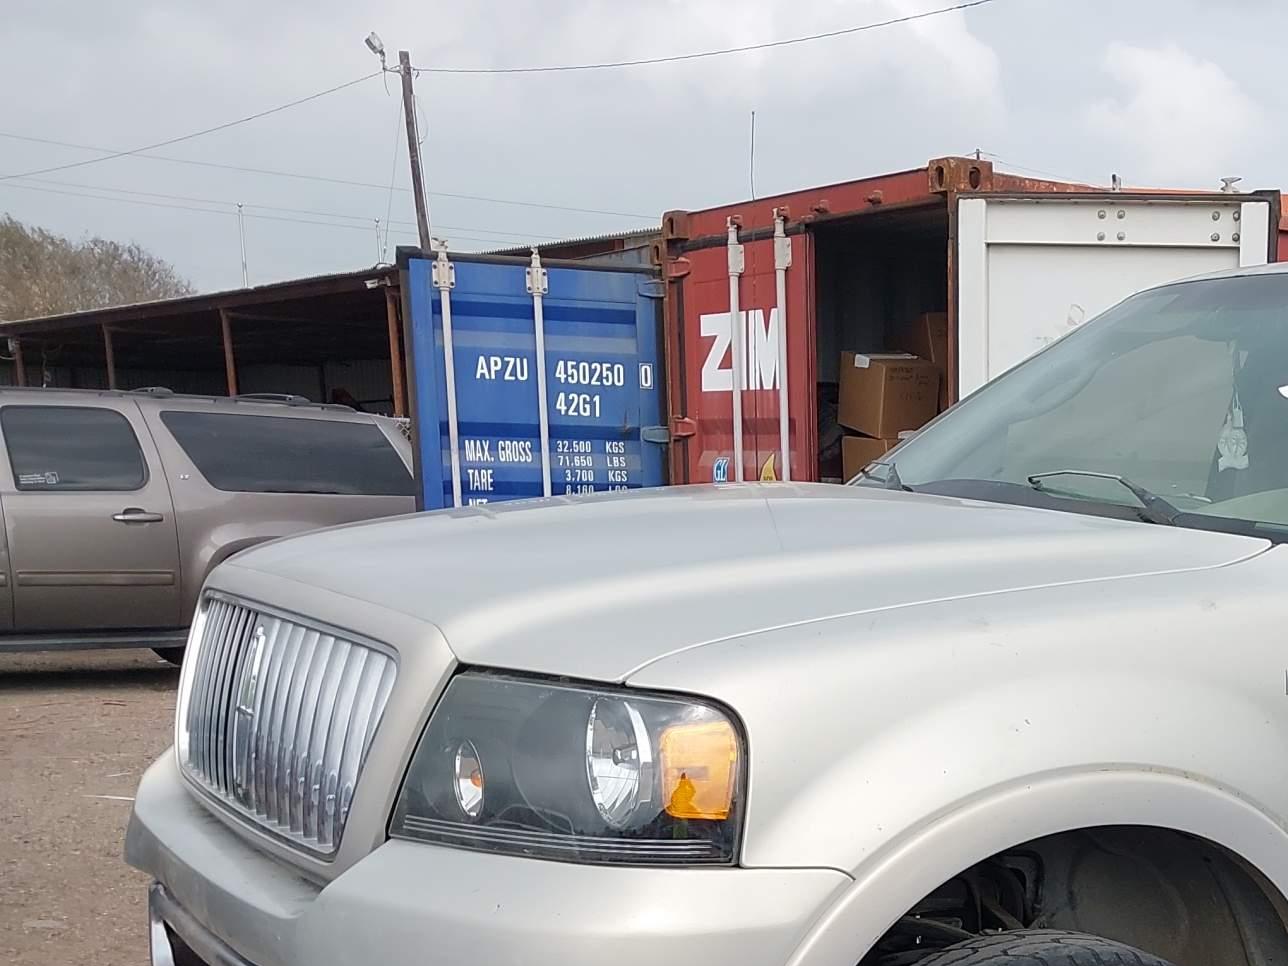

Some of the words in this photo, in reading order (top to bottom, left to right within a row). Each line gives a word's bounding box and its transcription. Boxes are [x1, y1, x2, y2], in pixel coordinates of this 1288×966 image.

[700, 308, 780, 392] ZIM
[475, 355, 529, 381] APZU
[555, 360, 625, 387] 450250
[640, 365, 652, 387] 0
[555, 392, 601, 418] 42G1
[464, 440, 495, 462] MAX.
[498, 440, 533, 463] GROSS
[556, 440, 592, 453] 32.500
[605, 441, 625, 454] KGS
[557, 455, 593, 467] 71.650
[606, 455, 627, 467] LBS
[467, 469, 494, 491] TARE
[564, 470, 594, 482] 3.700
[607, 470, 628, 482] KGS
